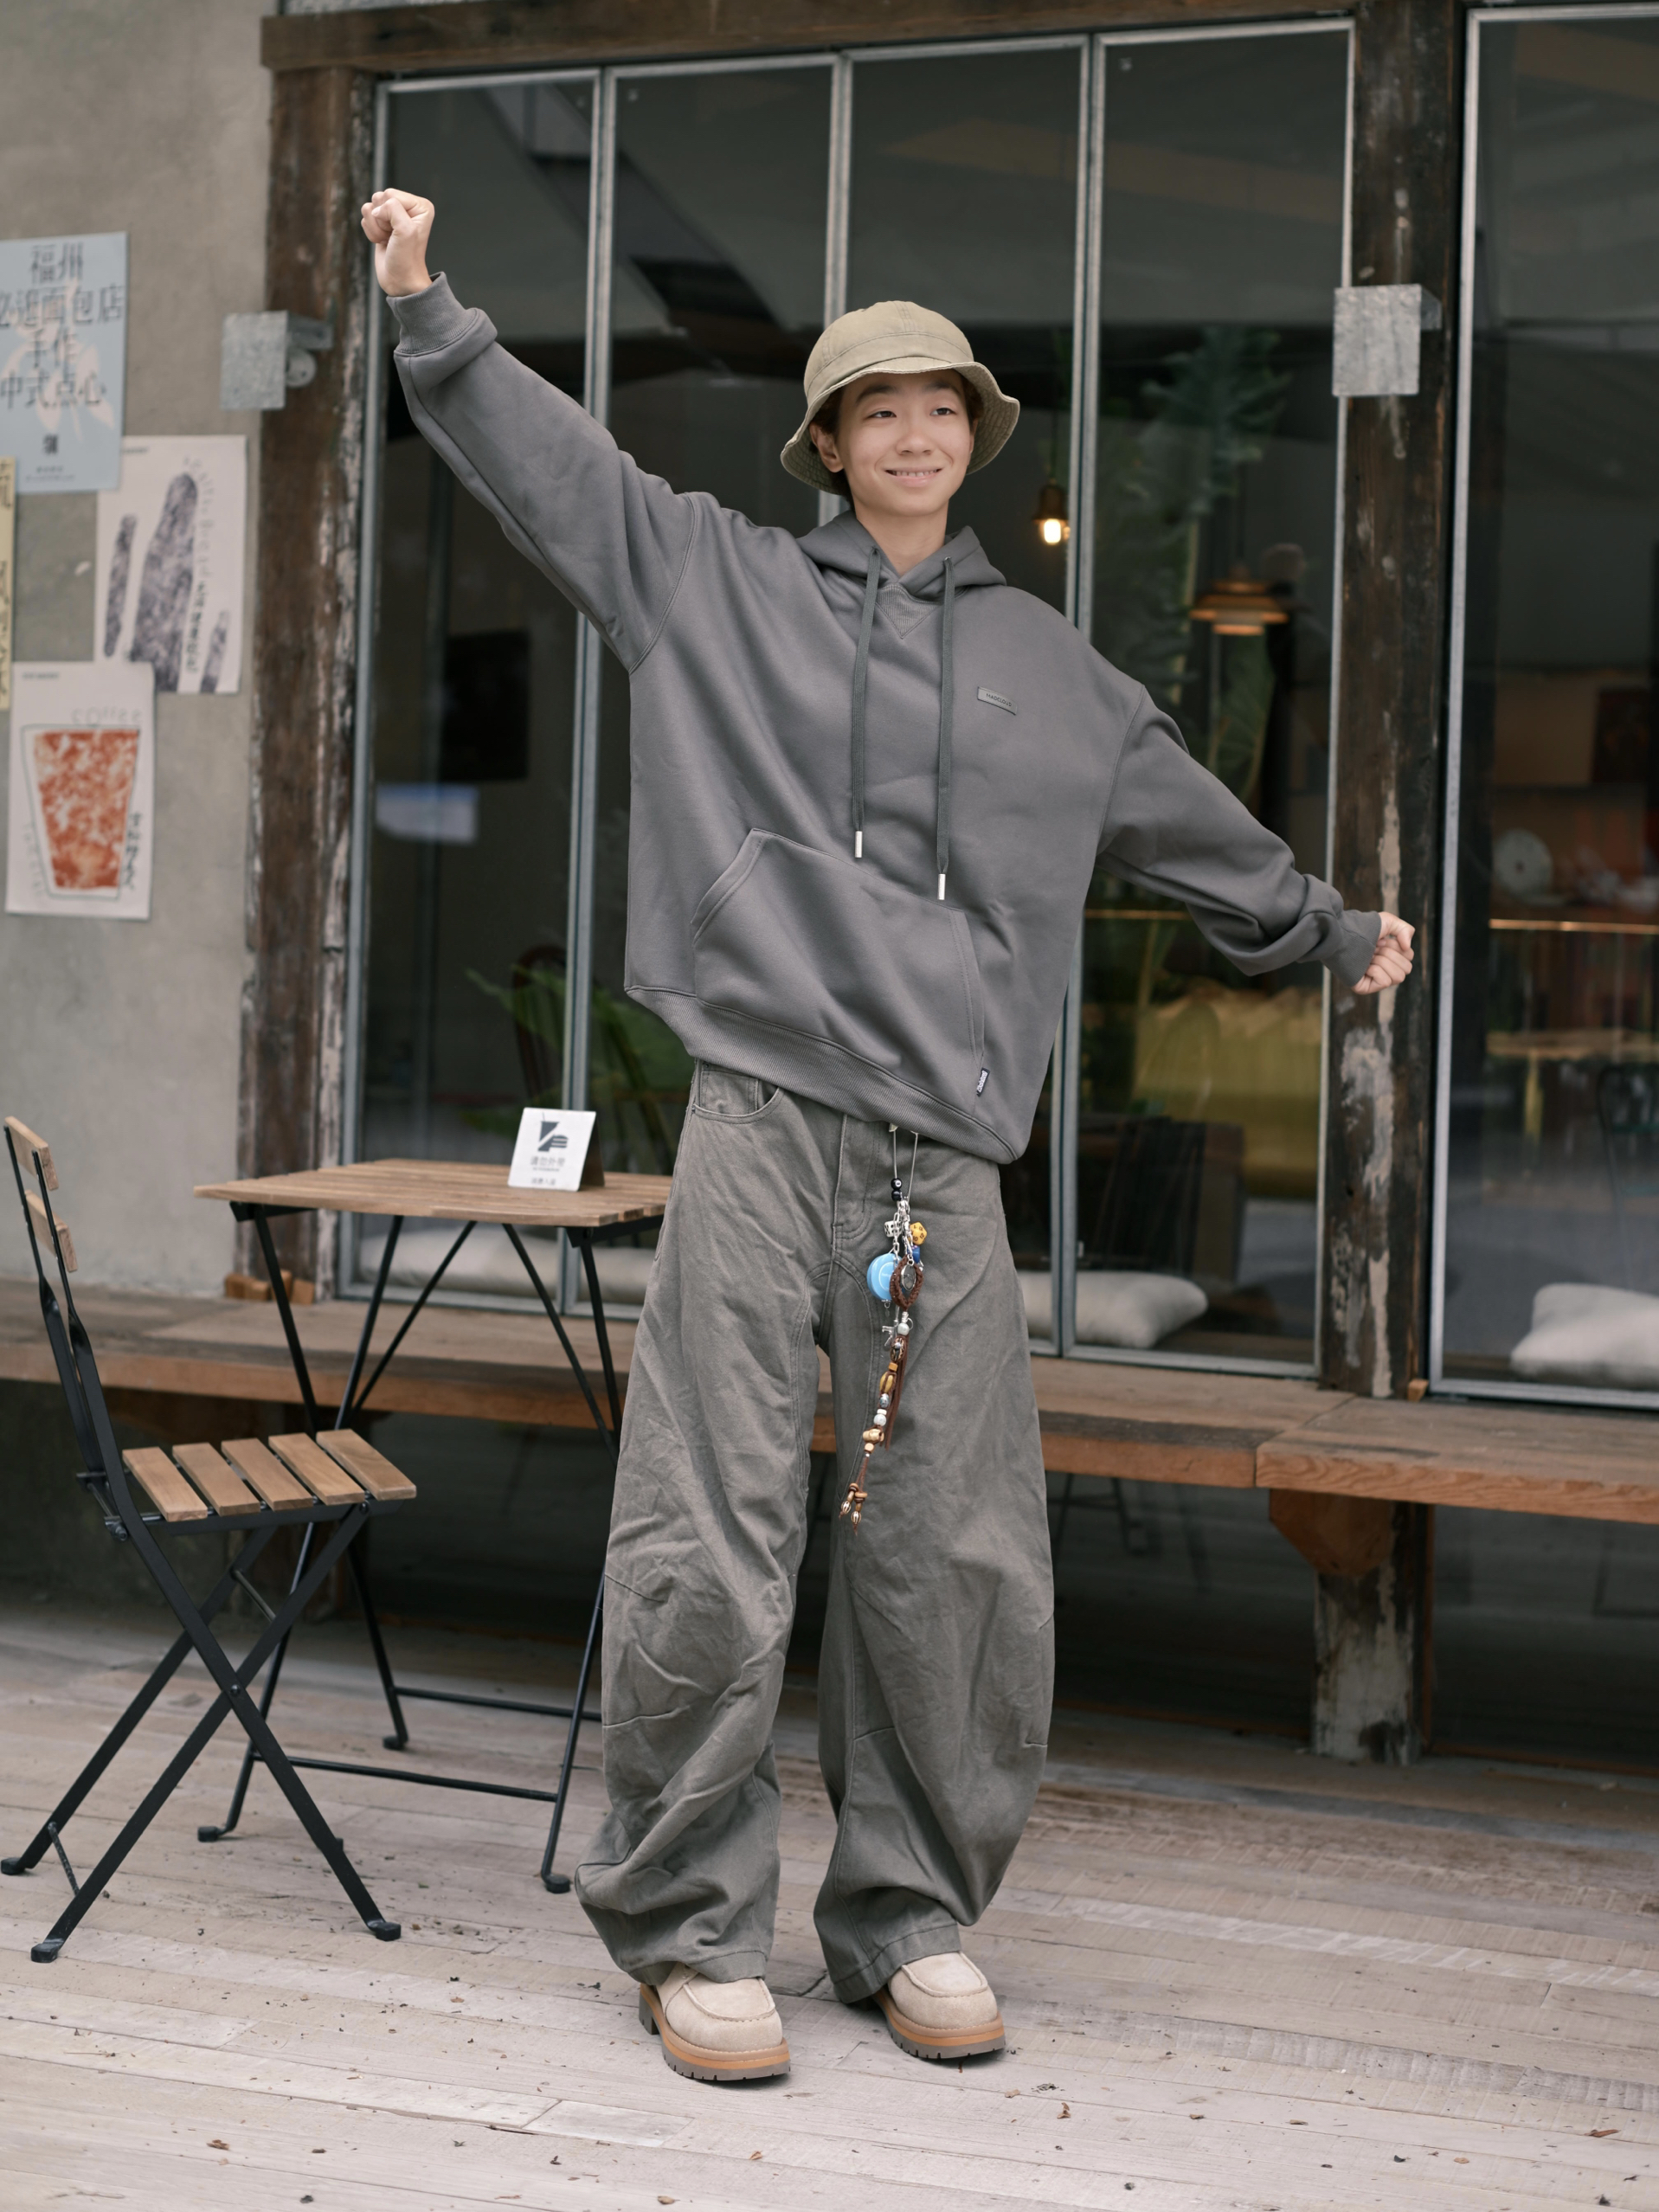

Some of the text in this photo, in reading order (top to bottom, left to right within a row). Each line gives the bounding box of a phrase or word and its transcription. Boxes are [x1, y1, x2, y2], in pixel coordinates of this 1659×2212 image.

[31, 242, 84, 284] 福州
[1, 369, 106, 409] 中式点心
